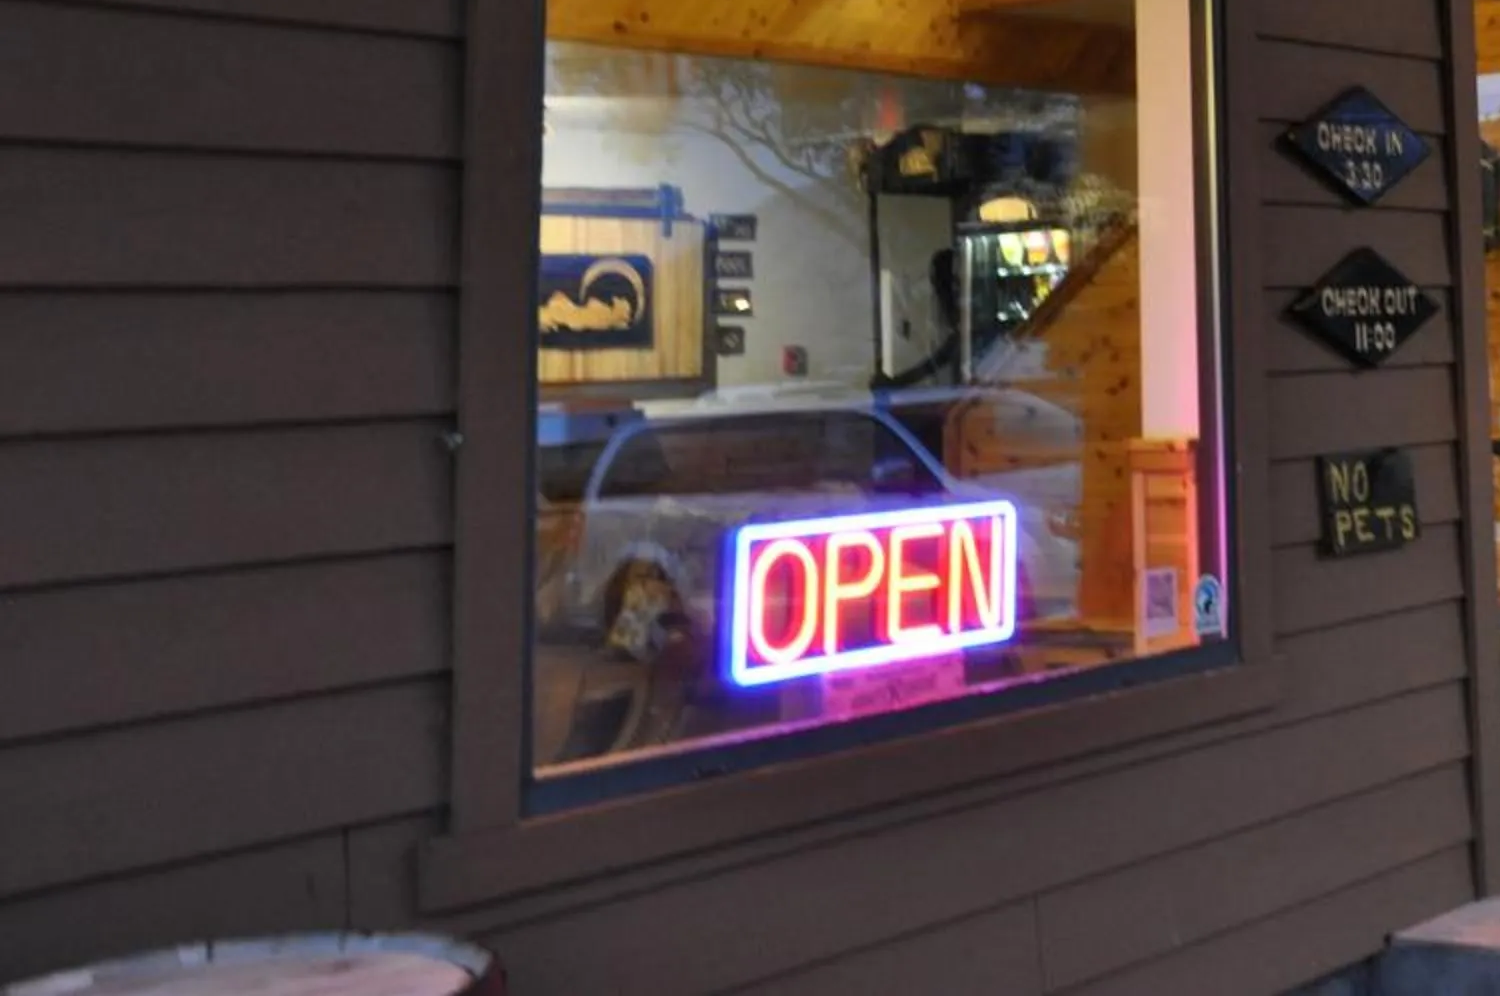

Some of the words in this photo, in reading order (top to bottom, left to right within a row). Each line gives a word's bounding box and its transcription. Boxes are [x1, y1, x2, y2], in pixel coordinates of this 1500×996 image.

[1318, 121, 1376, 154] CHECK
[1384, 129, 1403, 156] IN
[1322, 286, 1381, 317] CHECK
[1384, 286, 1416, 315] OUT
[1329, 460, 1369, 503] NO
[1335, 505, 1415, 546] PETS
[749, 515, 1002, 664] OPEN
